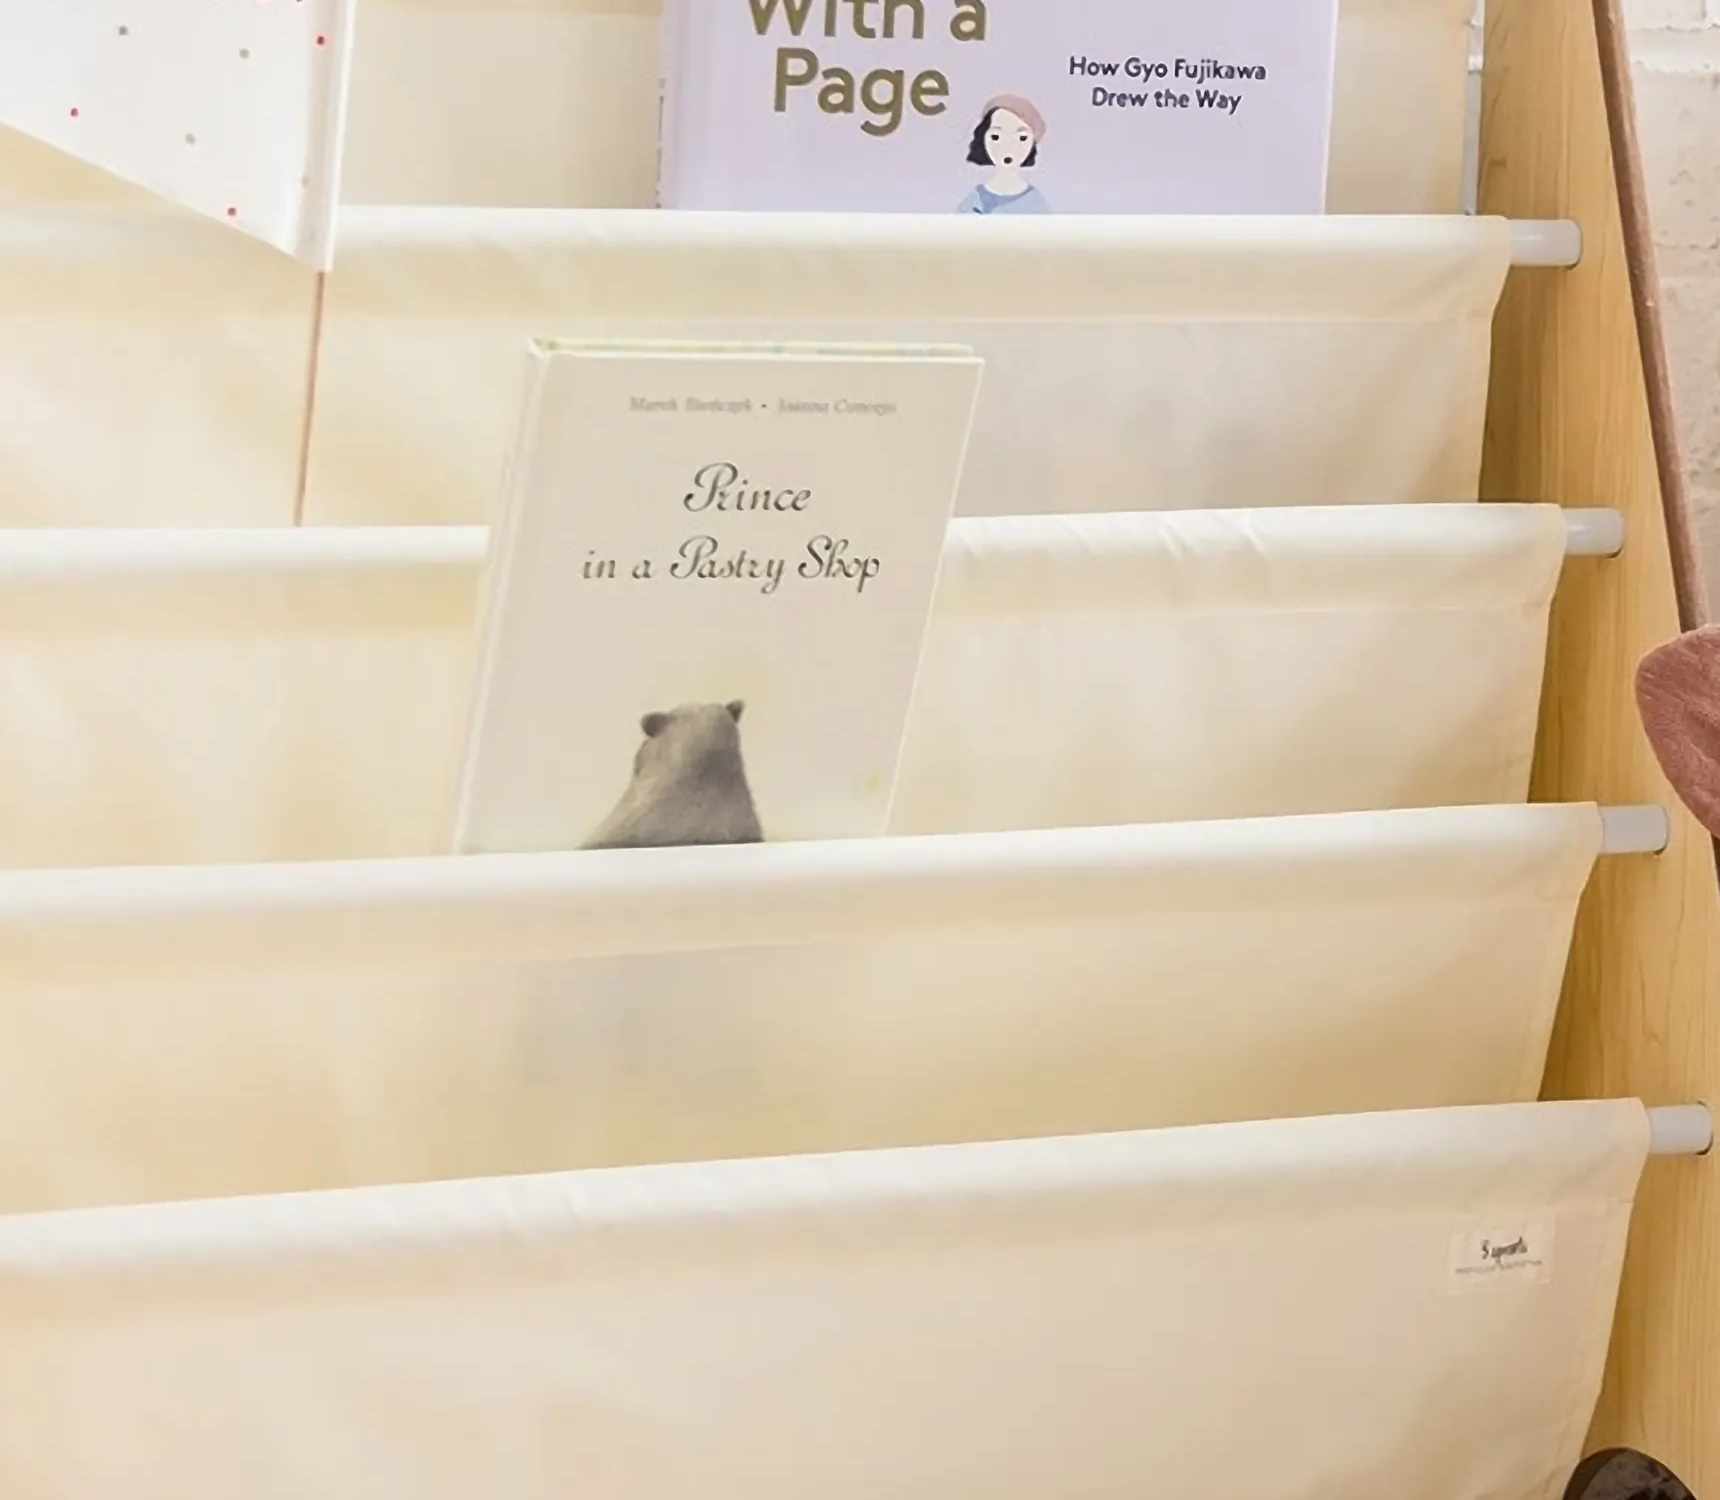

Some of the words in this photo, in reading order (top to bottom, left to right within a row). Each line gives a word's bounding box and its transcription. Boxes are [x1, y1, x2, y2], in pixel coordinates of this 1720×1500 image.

[773, 47, 951, 138] Page
[1068, 55, 1121, 77] How
[1123, 56, 1169, 83] Gyo
[1173, 57, 1267, 85] Fujikawa
[1091, 86, 1149, 108] Drew
[1153, 88, 1190, 109] the
[1195, 88, 1243, 116] Way
[682, 461, 812, 513] Prince
[582, 549, 617, 580] in
[631, 558, 653, 580] a
[669, 534, 786, 596] Pastry
[797, 533, 881, 594] Shop
